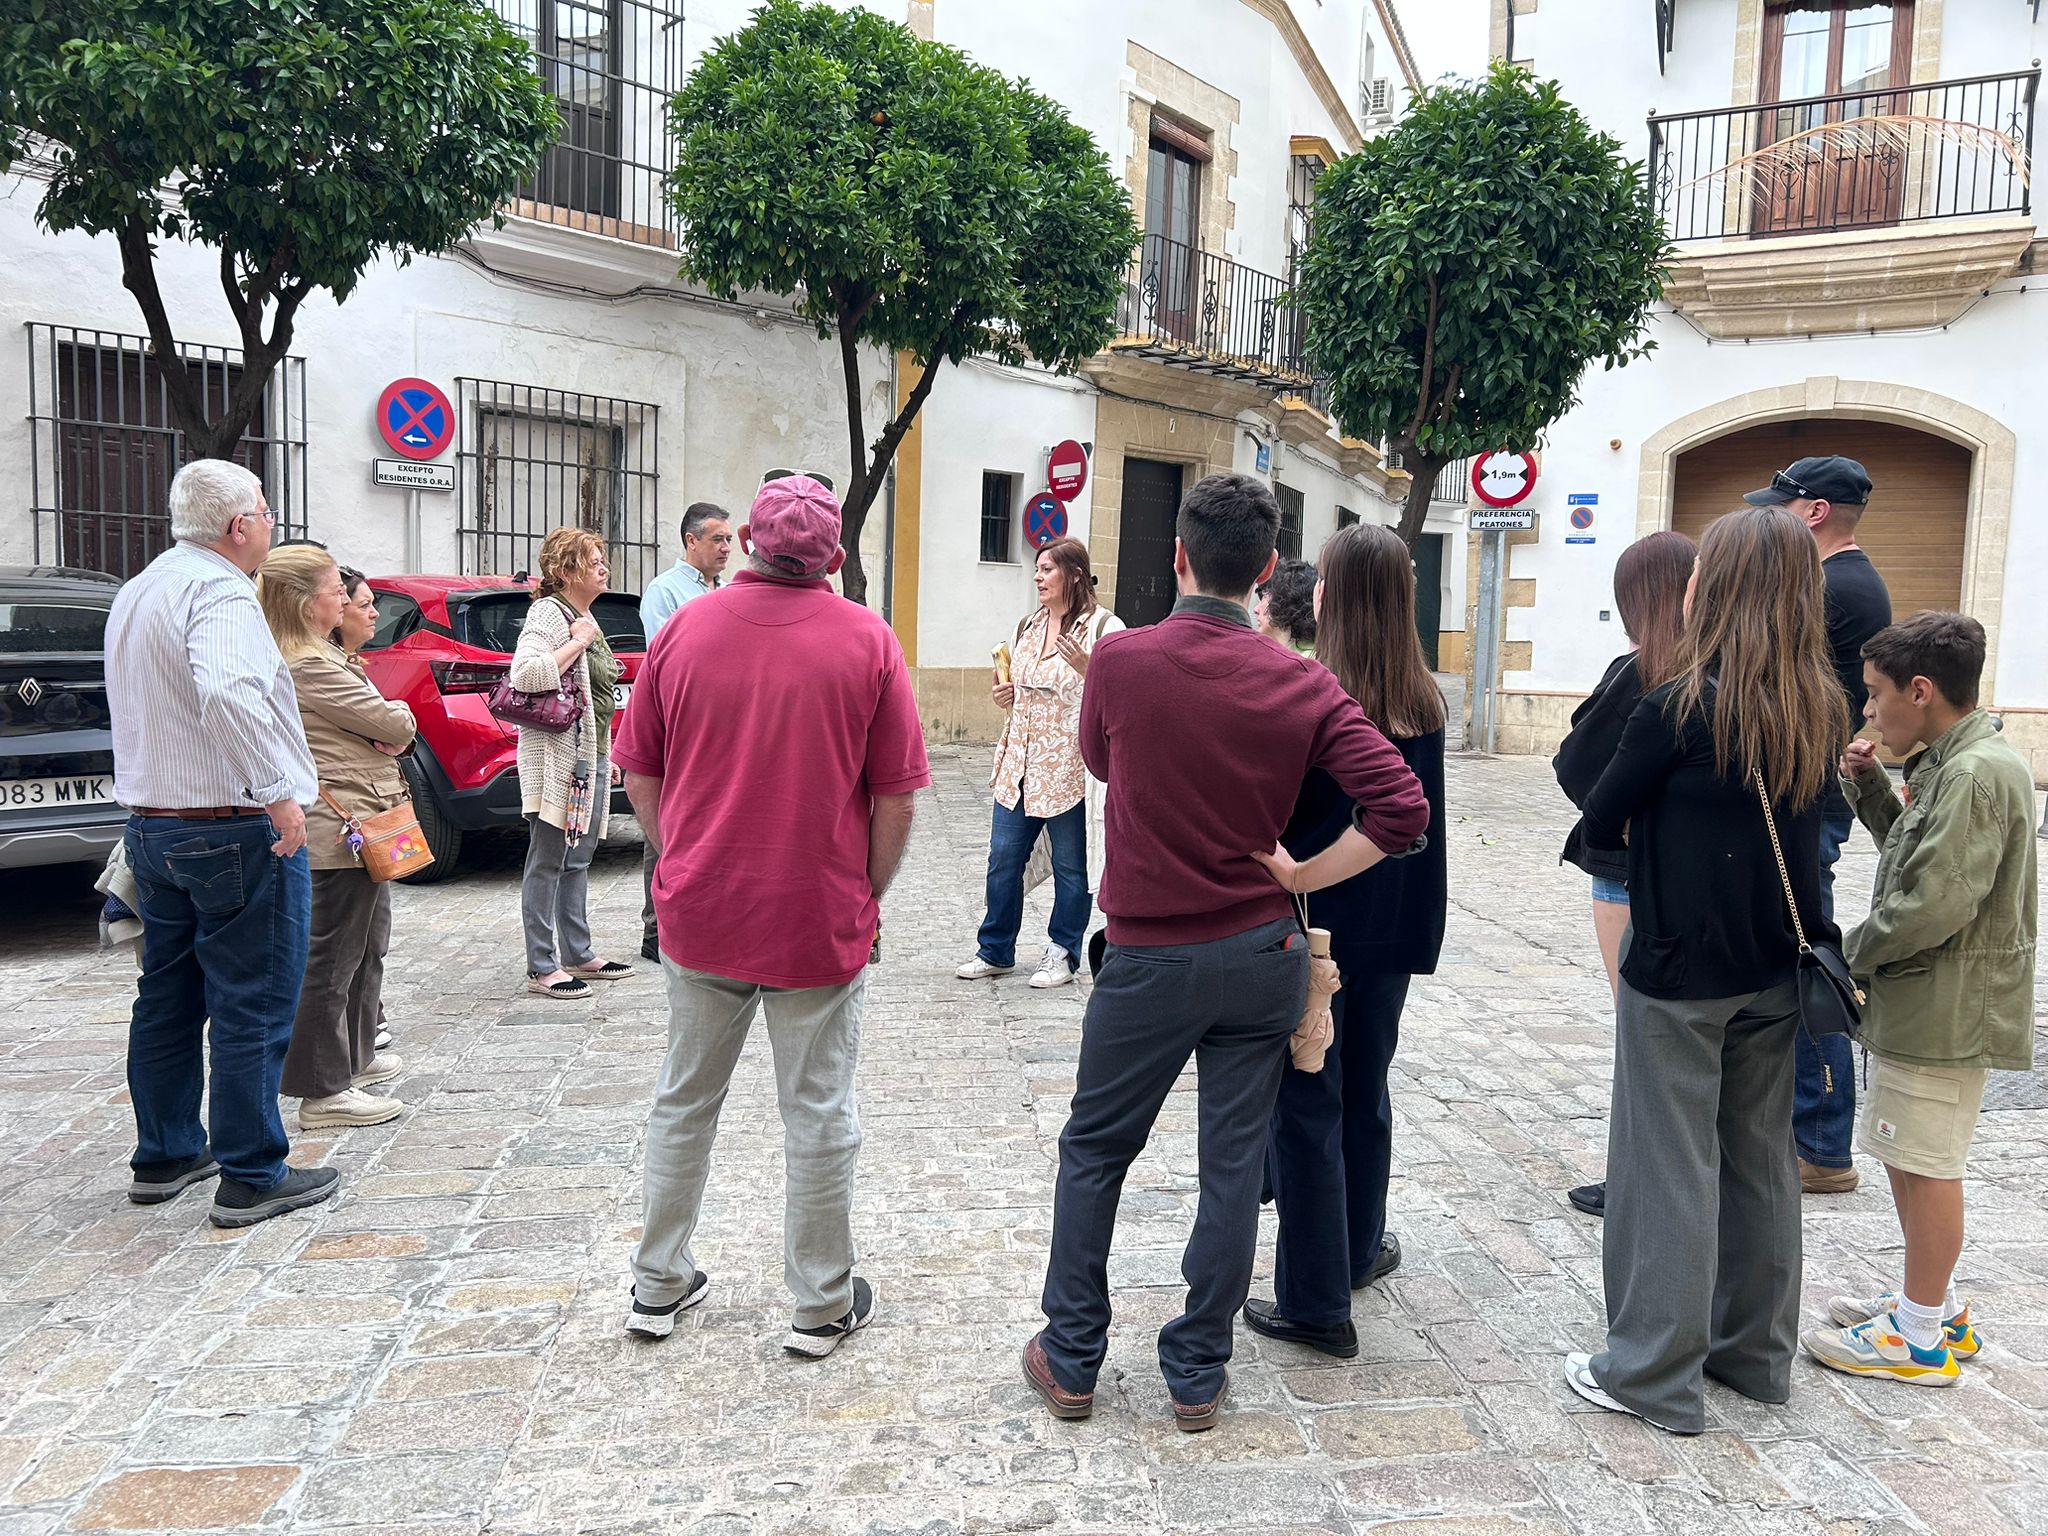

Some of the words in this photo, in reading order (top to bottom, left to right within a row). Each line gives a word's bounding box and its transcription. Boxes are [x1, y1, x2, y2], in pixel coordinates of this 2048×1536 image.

[397, 464, 434, 474] EXCEPTO
[1491, 469, 1516, 480] 1,9m
[378, 473, 428, 484] RESIDENTES
[429, 478, 453, 487] O.R.A.
[54, 779, 106, 802] MWK
